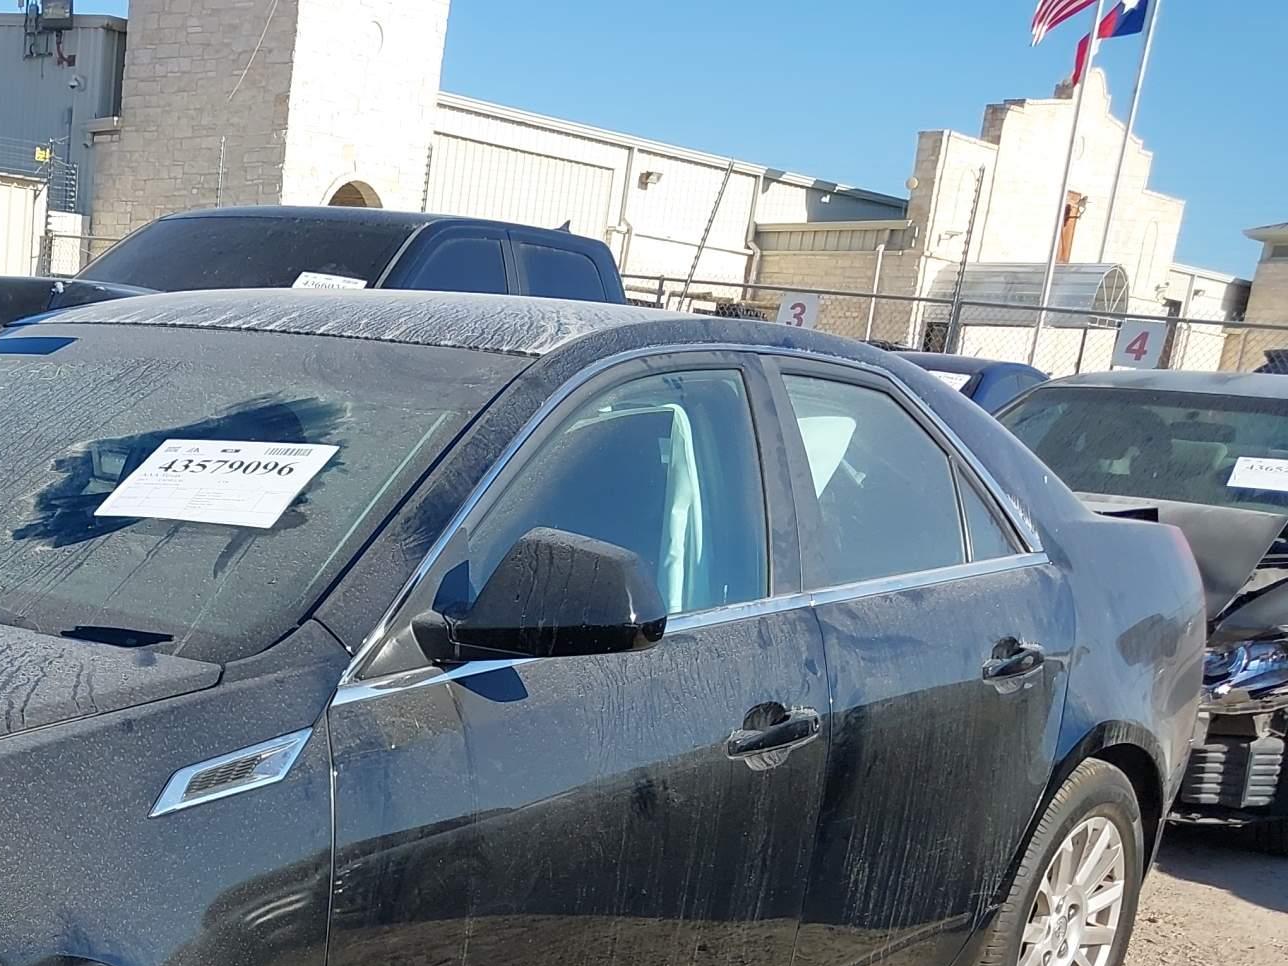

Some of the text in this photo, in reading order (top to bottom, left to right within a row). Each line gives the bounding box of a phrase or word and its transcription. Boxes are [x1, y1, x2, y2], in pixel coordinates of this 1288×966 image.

[786, 303, 806, 327] 3
[1125, 331, 1149, 361] 4
[158, 457, 300, 478] 43579096
